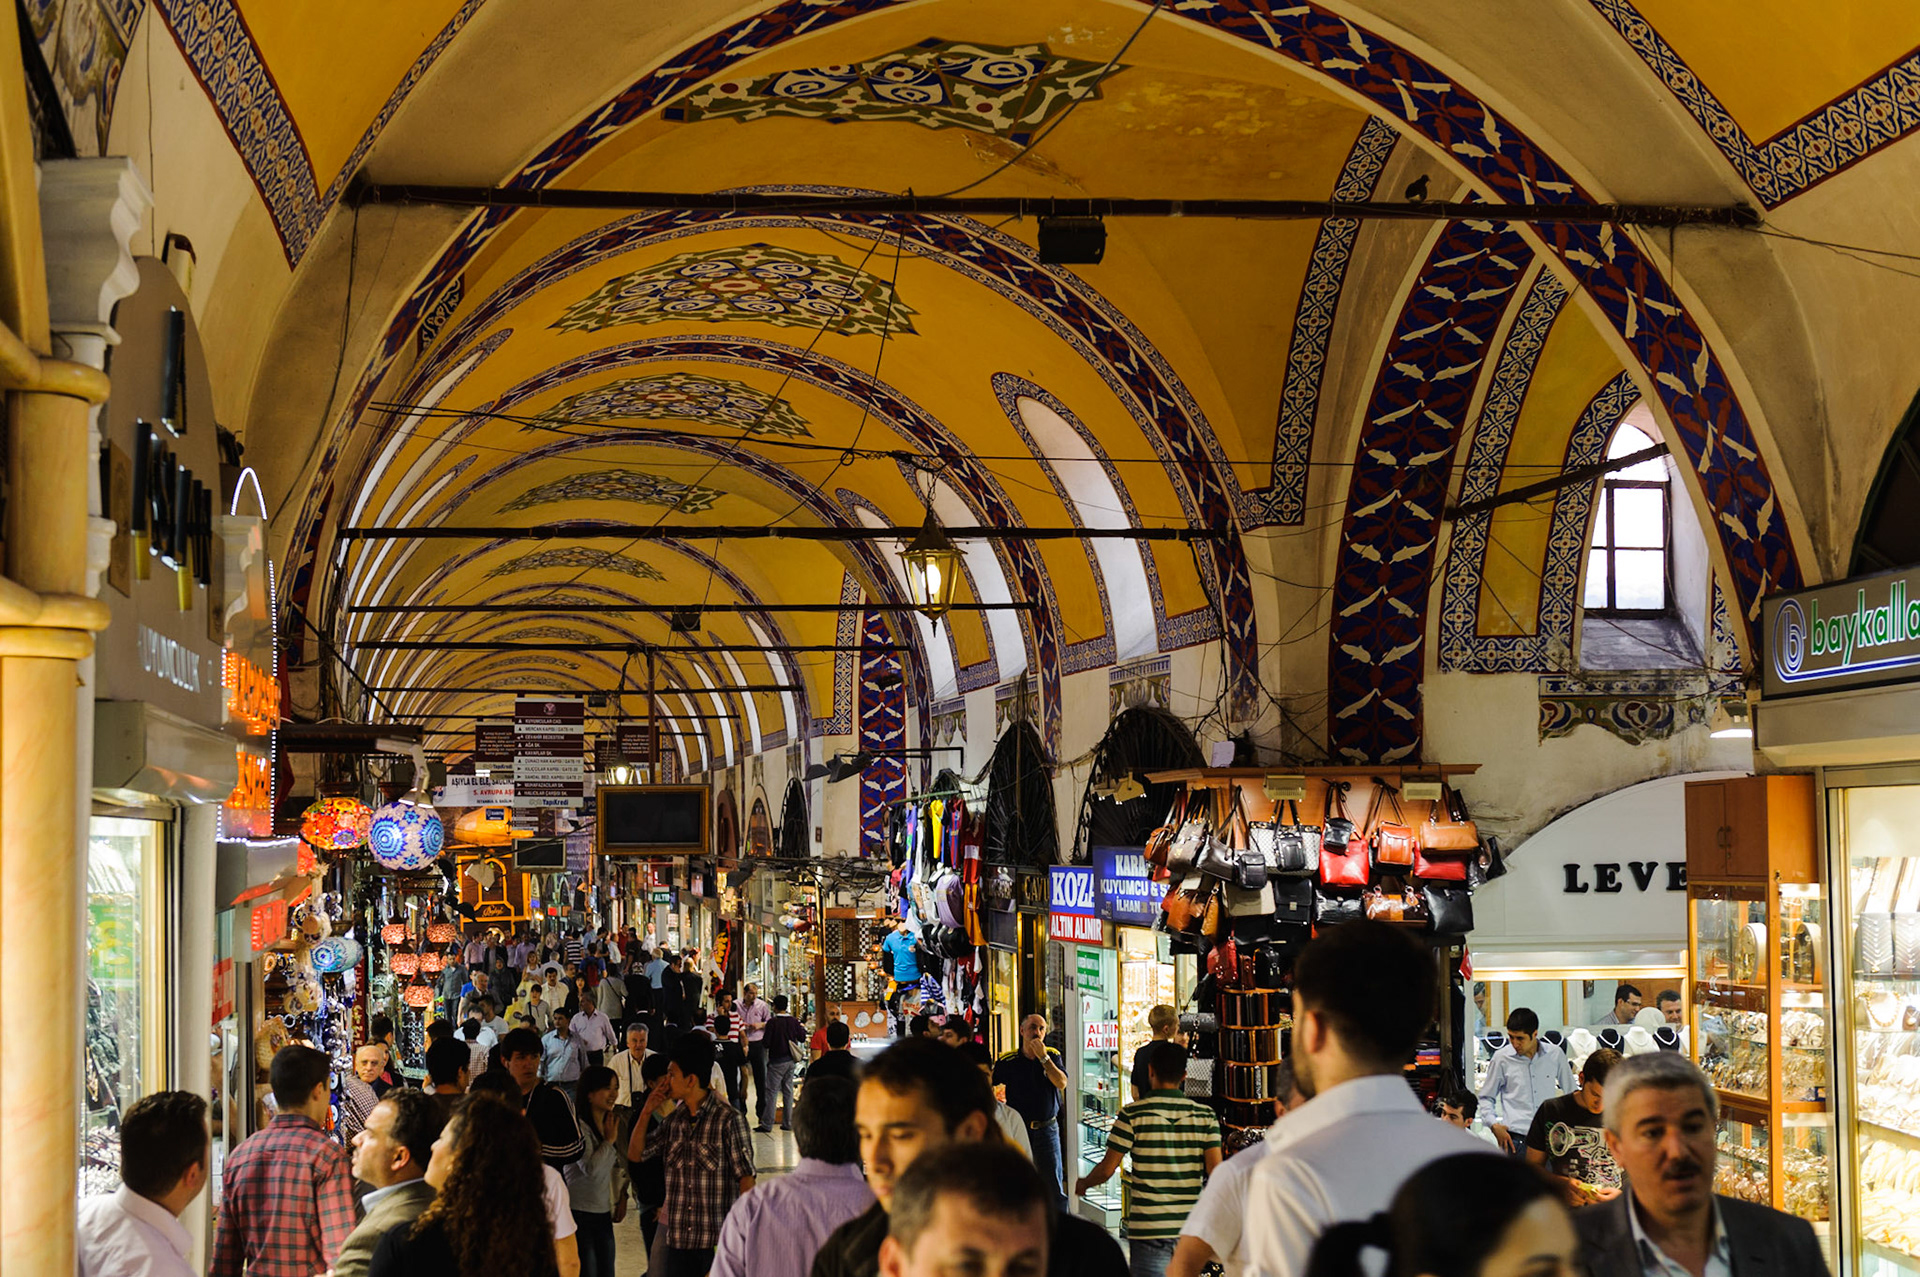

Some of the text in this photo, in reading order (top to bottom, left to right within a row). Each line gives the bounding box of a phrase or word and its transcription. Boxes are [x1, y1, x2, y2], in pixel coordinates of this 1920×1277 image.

[1100, 879, 1149, 896] KUYUMCU
[1116, 895, 1140, 913] İLHAN
[1051, 915, 1102, 941] ALTIN ALINIR
[1087, 1037, 1119, 1047] ALINI
